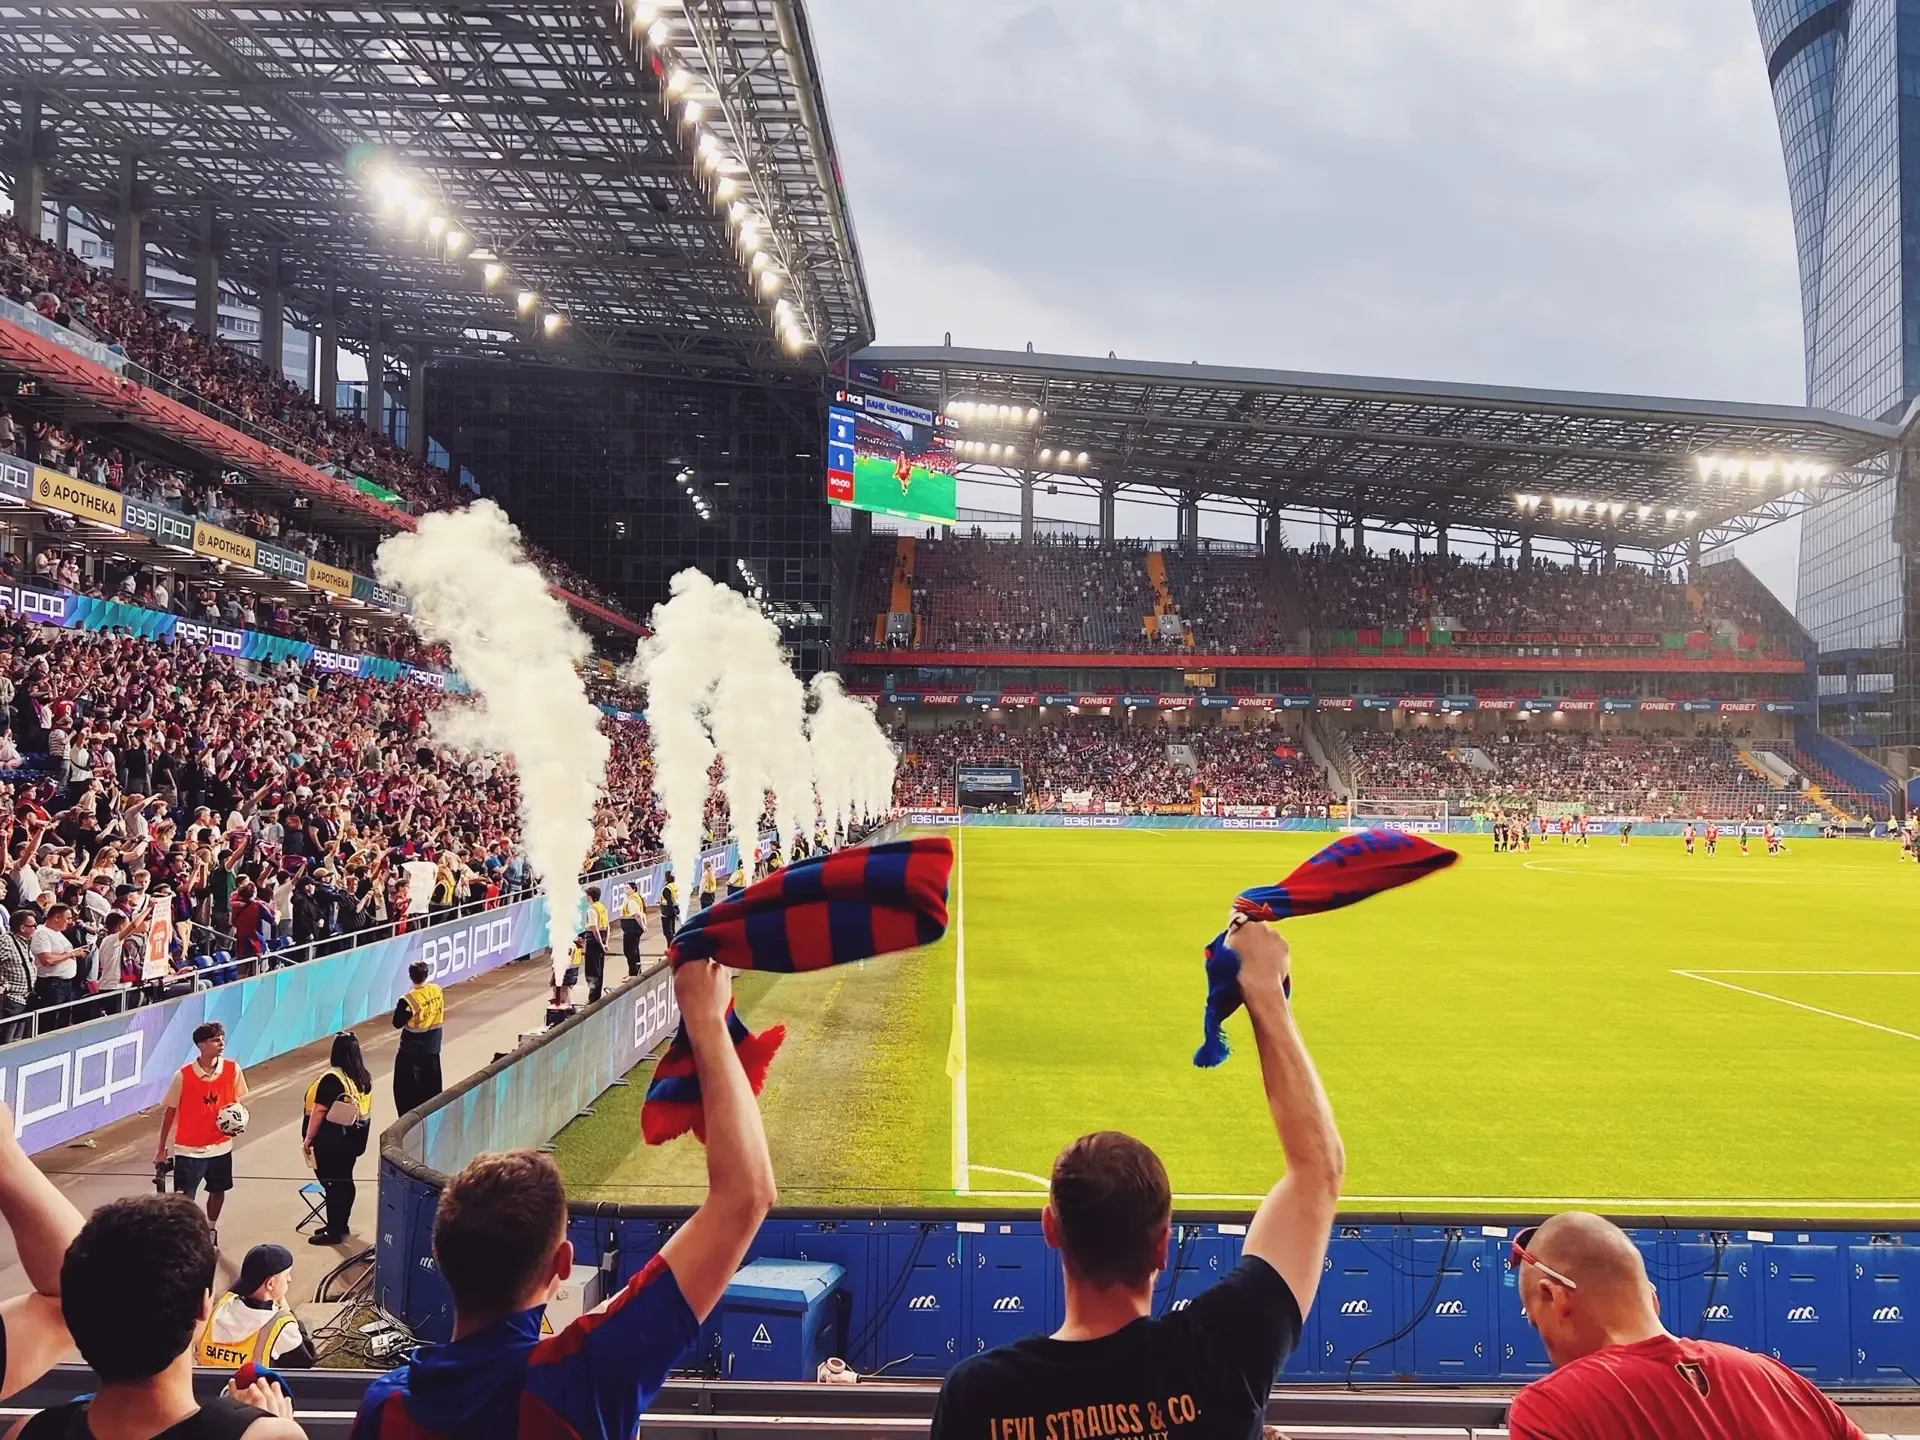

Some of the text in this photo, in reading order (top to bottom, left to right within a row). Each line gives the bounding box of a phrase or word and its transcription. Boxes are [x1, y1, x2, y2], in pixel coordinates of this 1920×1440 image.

[847, 393, 863, 406] ПСБ
[866, 398, 931, 422] БАНК ЧЕМПИОНОВ
[944, 417, 959, 429] ПСБ
[837, 453, 845, 467] 1
[830, 477, 851, 489] 90:00
[53, 484, 117, 517] APOTHEKA
[207, 535, 251, 560] APOTHEKA
[316, 570, 349, 590] APOTHEKA
[893, 613, 905, 622] 513
[1161, 616, 1173, 625] 514
[1435, 618, 1447, 626] 515
[924, 695, 959, 704] FONBET
[1001, 696, 1036, 704] FONBET
[1079, 697, 1114, 705] FONBET
[1158, 697, 1194, 706] FONBET
[1237, 698, 1274, 706] FONBET
[1317, 699, 1353, 707] FONBET
[1398, 700, 1435, 708] FONBET
[1478, 700, 1515, 709] FONBET
[1559, 701, 1595, 709] FONBET
[1640, 702, 1677, 710] FONBET
[1720, 703, 1757, 711] FONBET
[1171, 746, 1184, 755] 214
[205, 1345, 248, 1365] SAFETY
[1045, 1403, 1144, 1440] STRAUSS
[1146, 1400, 1167, 1431] &
[1167, 1394, 1202, 1426] CO.
